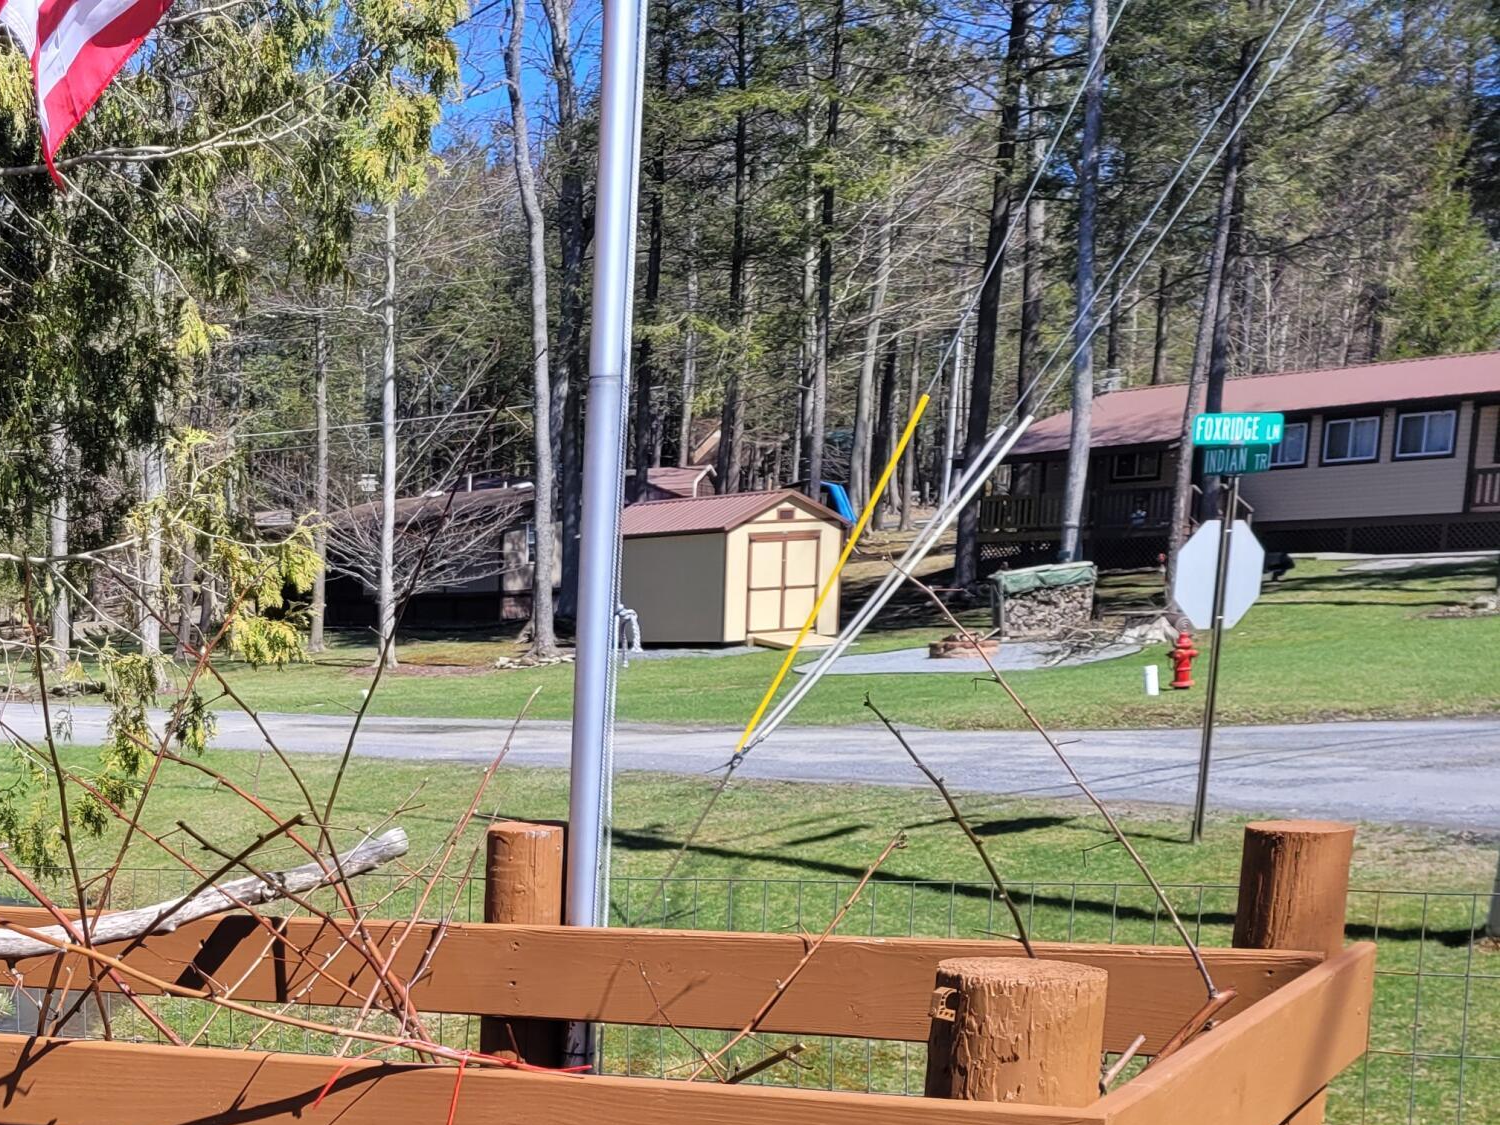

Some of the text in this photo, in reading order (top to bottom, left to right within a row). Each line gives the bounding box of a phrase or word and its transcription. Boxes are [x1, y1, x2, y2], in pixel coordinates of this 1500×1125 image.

[1195, 416, 1280, 441] FOXRIDGE LN
[1204, 448, 1248, 474] INDIAN
